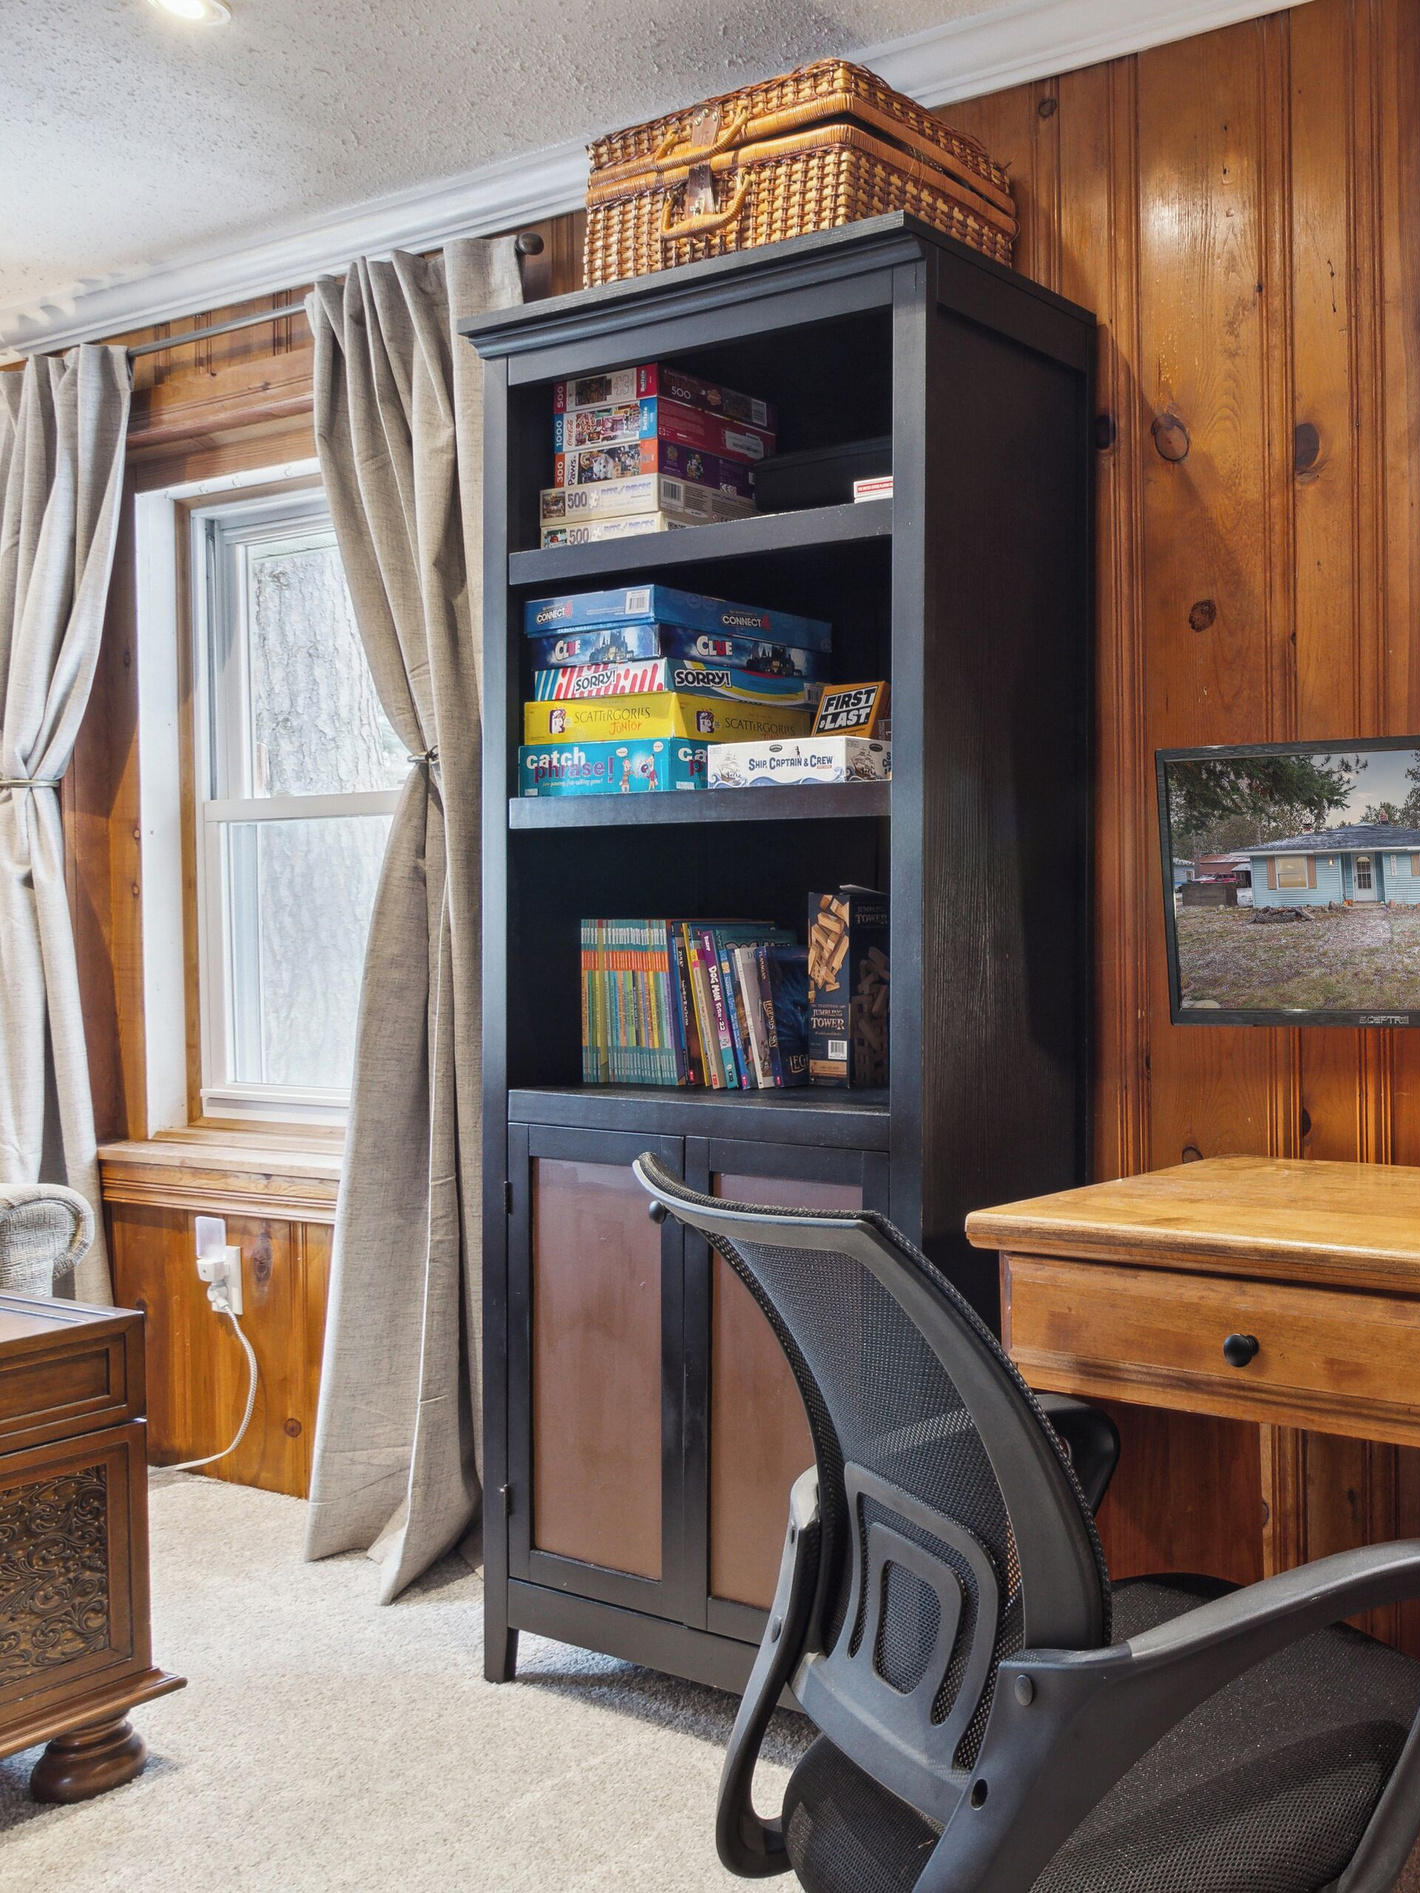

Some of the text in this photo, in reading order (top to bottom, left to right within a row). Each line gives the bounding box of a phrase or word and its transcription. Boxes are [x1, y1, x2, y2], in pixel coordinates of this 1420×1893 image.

[671, 386, 692, 399] 500
[556, 461, 564, 483] 300
[567, 491, 588, 509] 500
[569, 528, 590, 545] 500
[536, 607, 566, 623] CONNECT
[564, 600, 573, 618] 4
[722, 614, 771, 633] CONNECT 4
[555, 640, 581, 661] CLUE
[696, 635, 733, 656] CLUE
[575, 669, 616, 692] SORRY!
[674, 670, 731, 687] SORRY!
[823, 688, 877, 713] FIRST
[574, 707, 651, 724] SCATTERGORIES
[725, 717, 796, 736] SCATTERGORIES
[525, 747, 587, 770] catch
[769, 756, 802, 770] CAPTAIN
[804, 759, 809, 767] &
[809, 754, 834, 769] CREW
[533, 756, 615, 784] phrase!
[708, 965, 716, 984] DOG
[711, 983, 722, 1002] MAN
[813, 1009, 843, 1017] JUMBLING
[1359, 1015, 1410, 1025] SCEPTRE
[810, 1017, 845, 1030] TOWER
